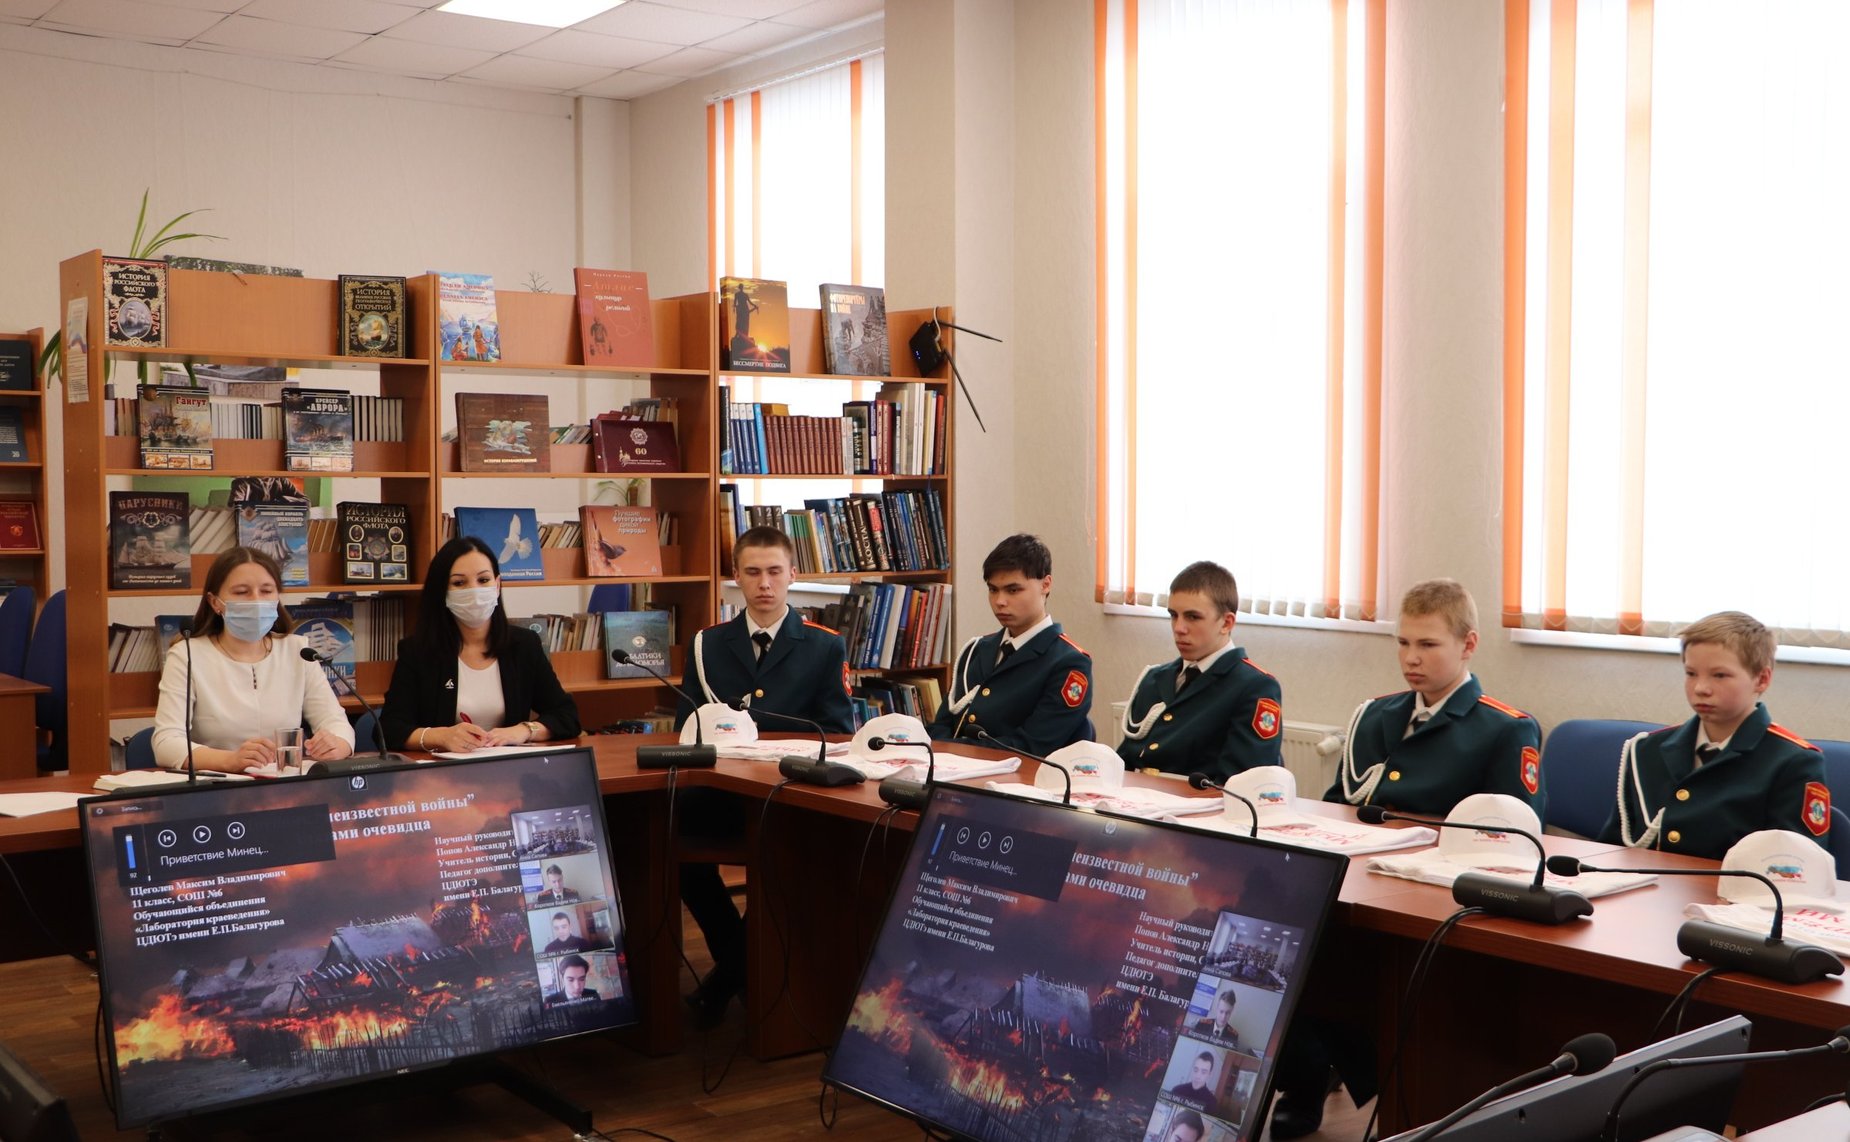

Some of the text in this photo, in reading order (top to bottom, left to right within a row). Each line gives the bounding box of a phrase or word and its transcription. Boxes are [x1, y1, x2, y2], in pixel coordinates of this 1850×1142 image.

[118, 273, 151, 281] ИСТОРИЯ
[176, 396, 207, 407] Гангут
[118, 498, 182, 510] ПАРУСНИКИ
[346, 504, 406, 517] ИСТОРИЯ
[346, 516, 406, 524] РОССИЙСКОГО
[363, 820, 431, 837] очевидца
[434, 833, 473, 846] Научный
[436, 847, 463, 856] Попов
[464, 842, 507, 852] Александр
[161, 850, 225, 867] Приветствие
[438, 857, 474, 867] Учитель
[475, 853, 511, 862] истории,
[949, 850, 990, 868] Приветствие
[440, 868, 472, 879] Педагог
[1146, 867, 1199, 887] войны”
[130, 870, 286, 896] Щеголев Максим Владимирович
[441, 878, 478, 891] ЦДЮТЭ
[920, 871, 1018, 904] Щеголев Максим Владимирович
[1089, 877, 1147, 900] очевидца
[132, 889, 223, 908] 11 класс, СОШ №6
[444, 892, 470, 901] имени
[942, 890, 960, 902] СОШ
[1481, 888, 1519, 903] VISSONIC
[133, 896, 266, 921] Обучающийся объединения
[912, 895, 994, 924] Обучающийся объединения
[135, 909, 270, 933] «Лаборатория краеведения»
[1139, 911, 1174, 927] Научный
[178, 929, 210, 939] имени
[1134, 924, 1159, 938] Попов
[1159, 931, 1201, 950] Александр
[1130, 938, 1162, 954] Учитель
[1163, 948, 1197, 964] истории,
[1709, 938, 1753, 956] VISSONIC
[1125, 951, 1155, 967] Педагог
[1120, 964, 1154, 982] ЦДЮТЭ
[1115, 980, 1141, 993] имени
